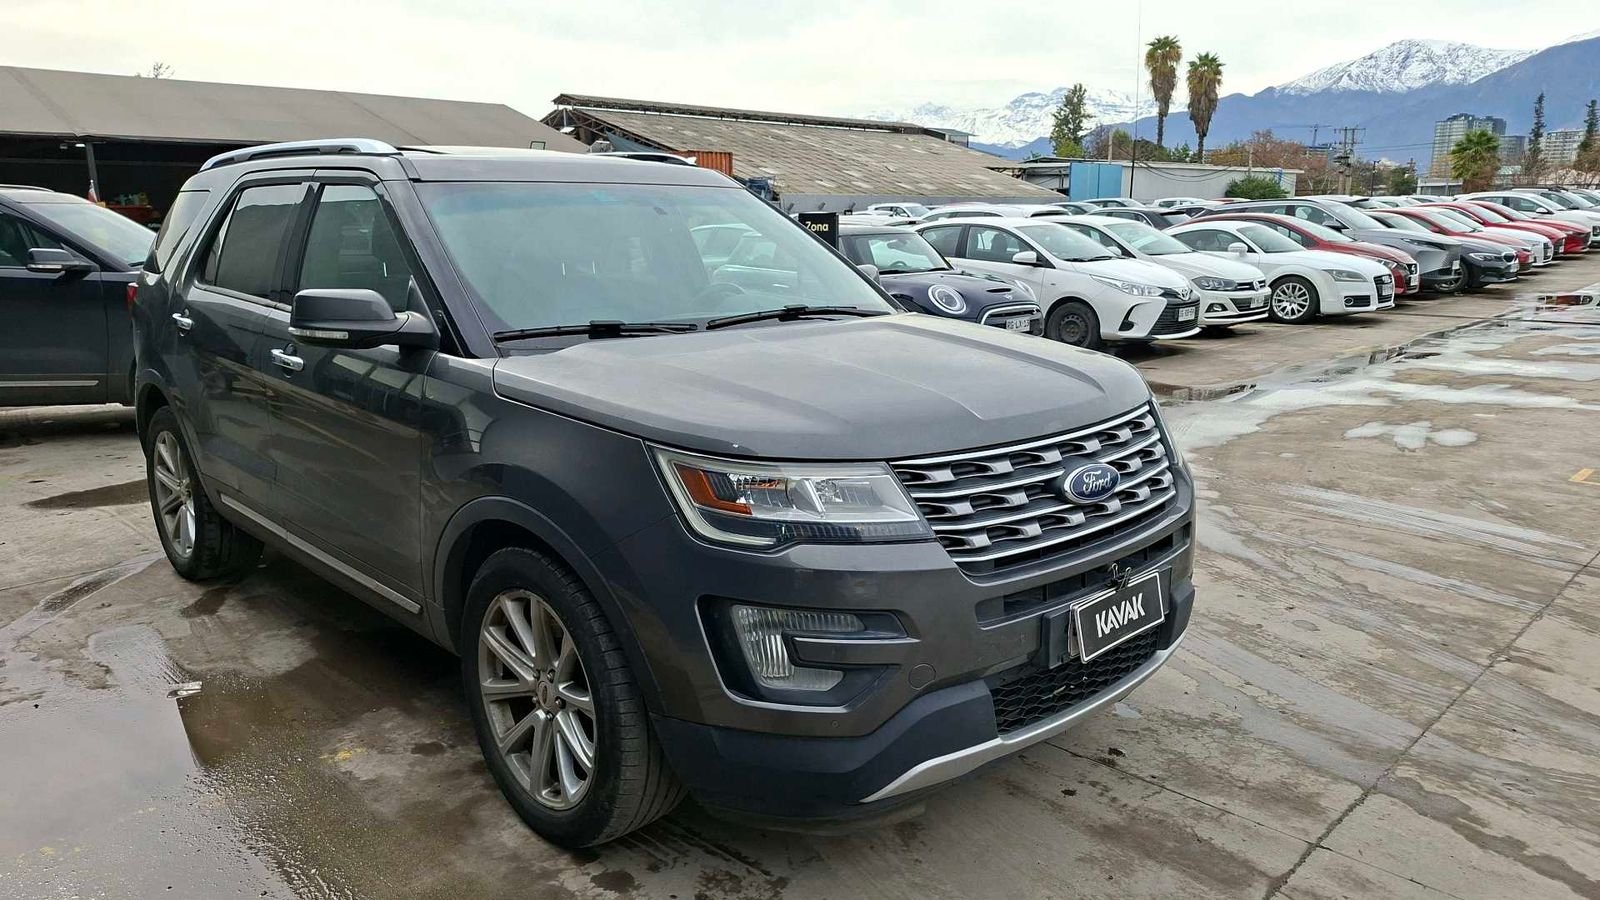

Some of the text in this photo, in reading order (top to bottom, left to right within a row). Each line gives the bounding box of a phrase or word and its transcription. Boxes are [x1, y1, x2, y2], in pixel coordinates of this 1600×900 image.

[805, 221, 829, 231] Zona
[1083, 469, 1112, 495] Ford
[1095, 592, 1146, 638] KAVAK
